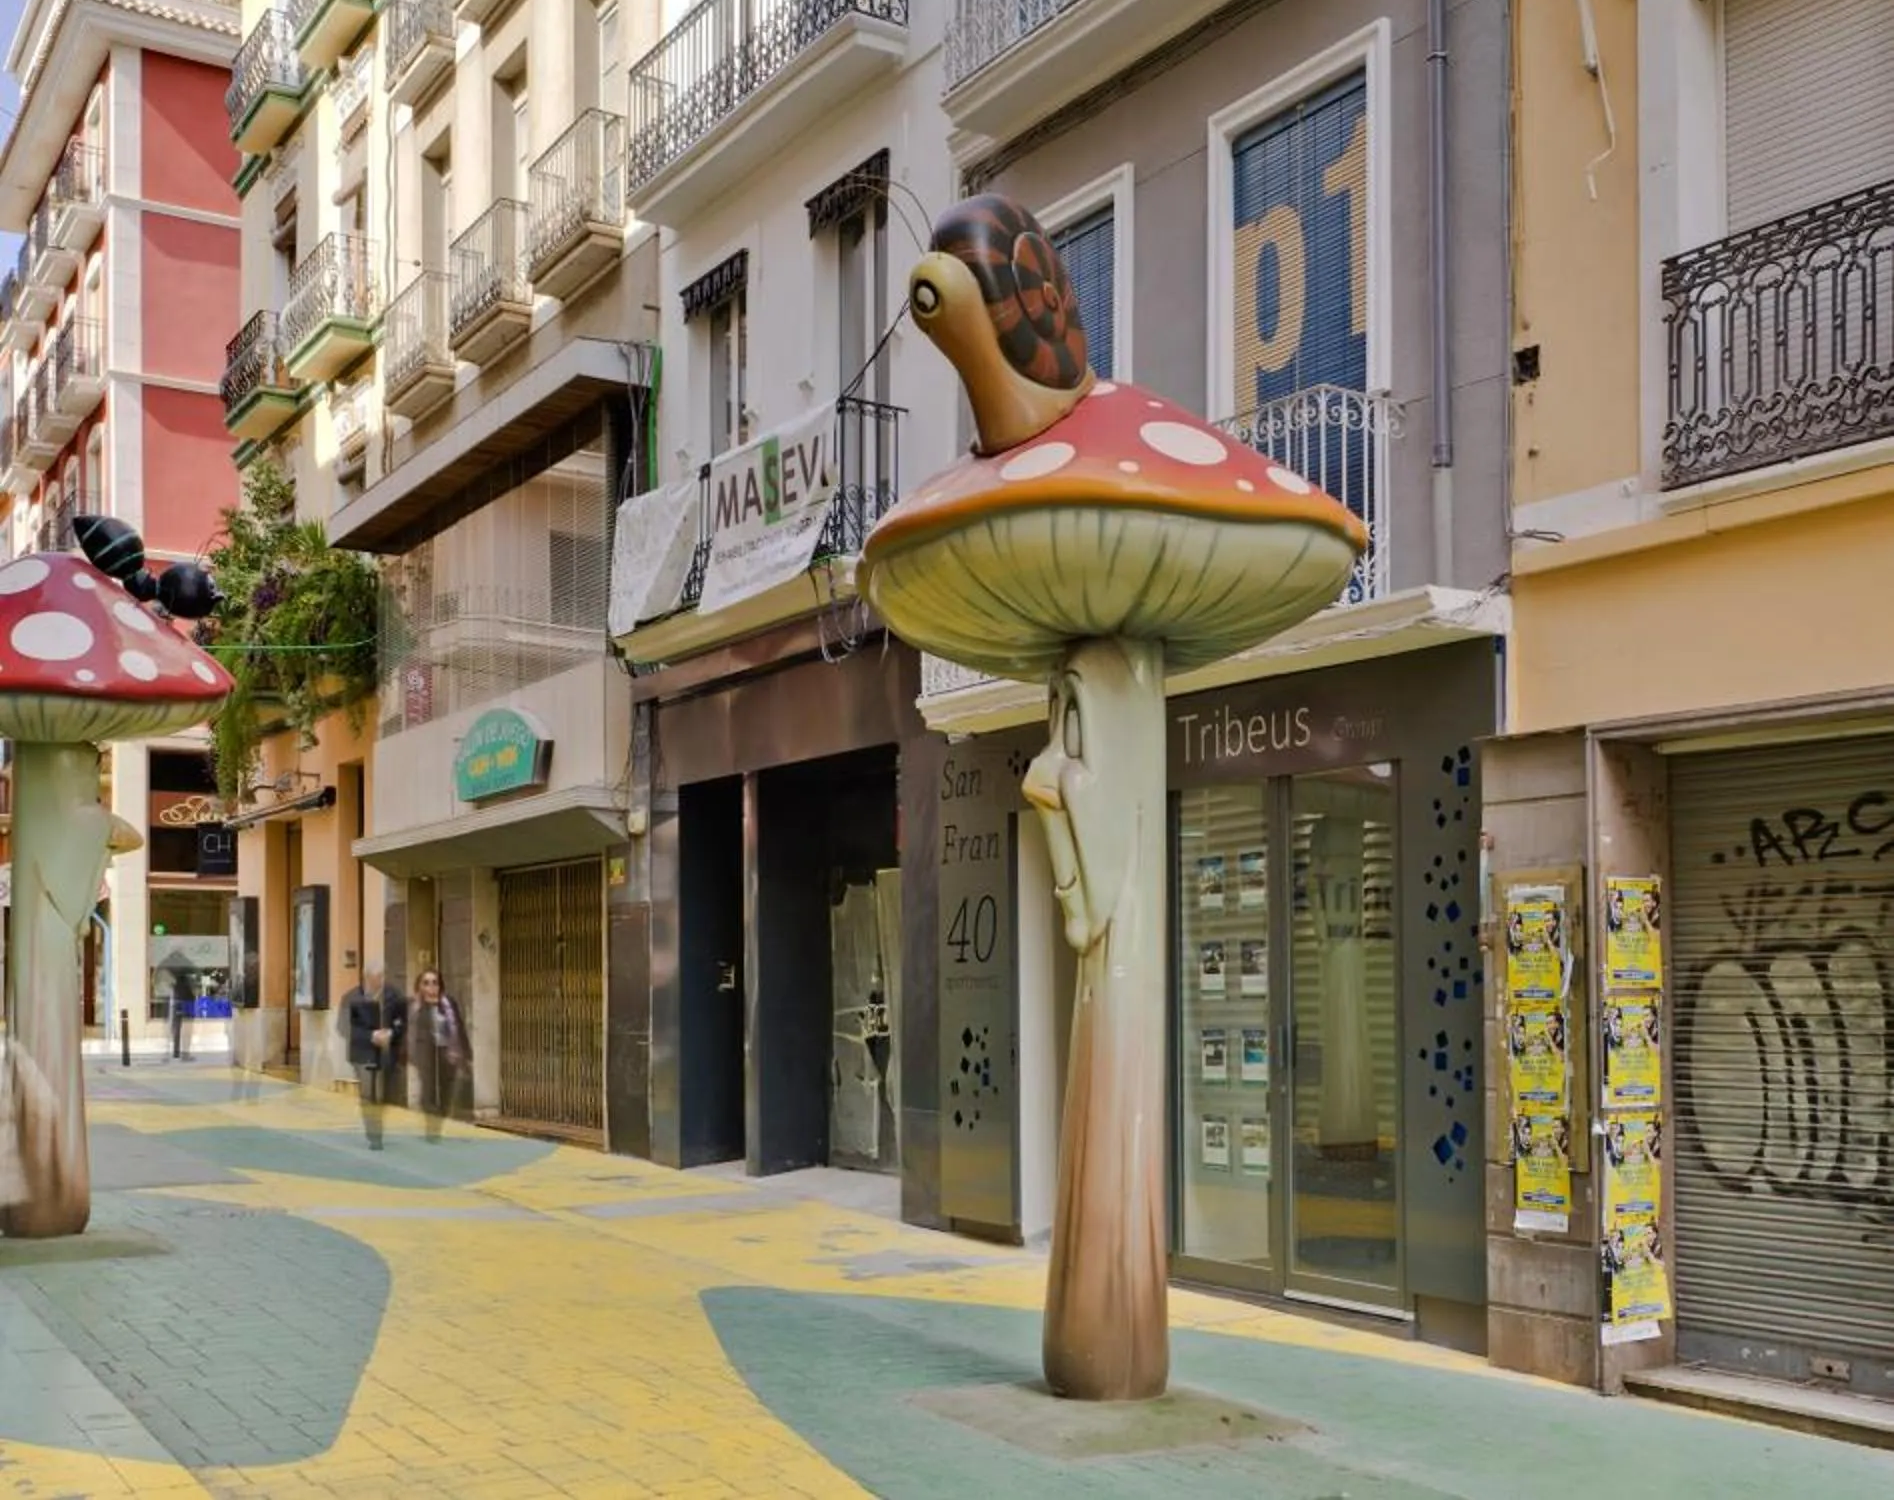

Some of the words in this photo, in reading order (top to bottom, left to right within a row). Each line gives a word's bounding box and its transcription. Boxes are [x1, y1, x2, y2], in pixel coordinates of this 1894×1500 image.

[1177, 704, 1312, 764] Tribeus
[940, 759, 981, 800] San
[941, 825, 999, 865] Fran
[946, 894, 998, 964] 40
